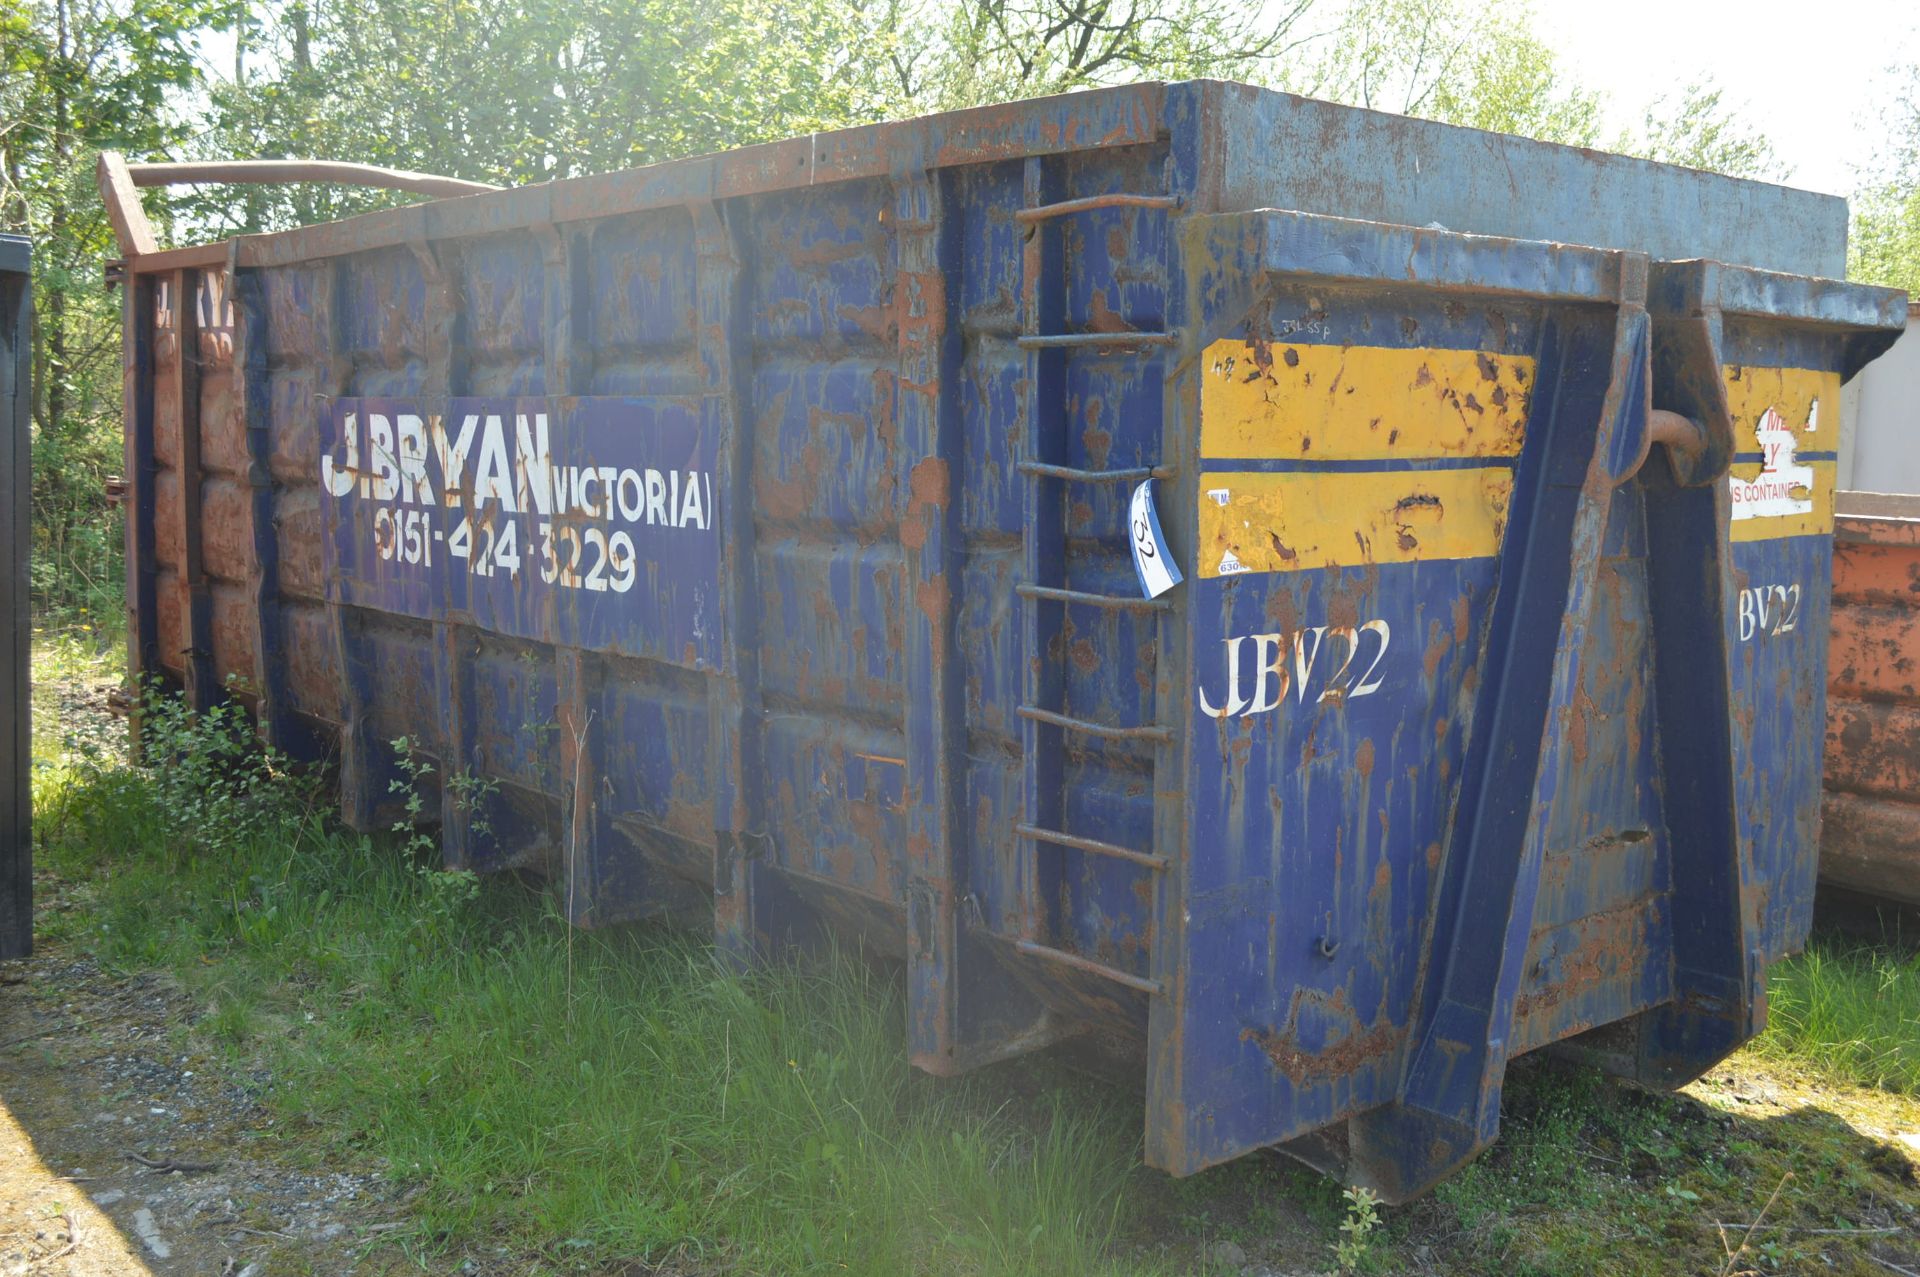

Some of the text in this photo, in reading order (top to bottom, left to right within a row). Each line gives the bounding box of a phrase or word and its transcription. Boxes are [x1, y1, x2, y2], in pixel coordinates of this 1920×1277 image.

[374, 507, 636, 593] 0151-424-3229
[1134, 512, 1155, 571] 32
[1199, 620, 1391, 718] JBV22
